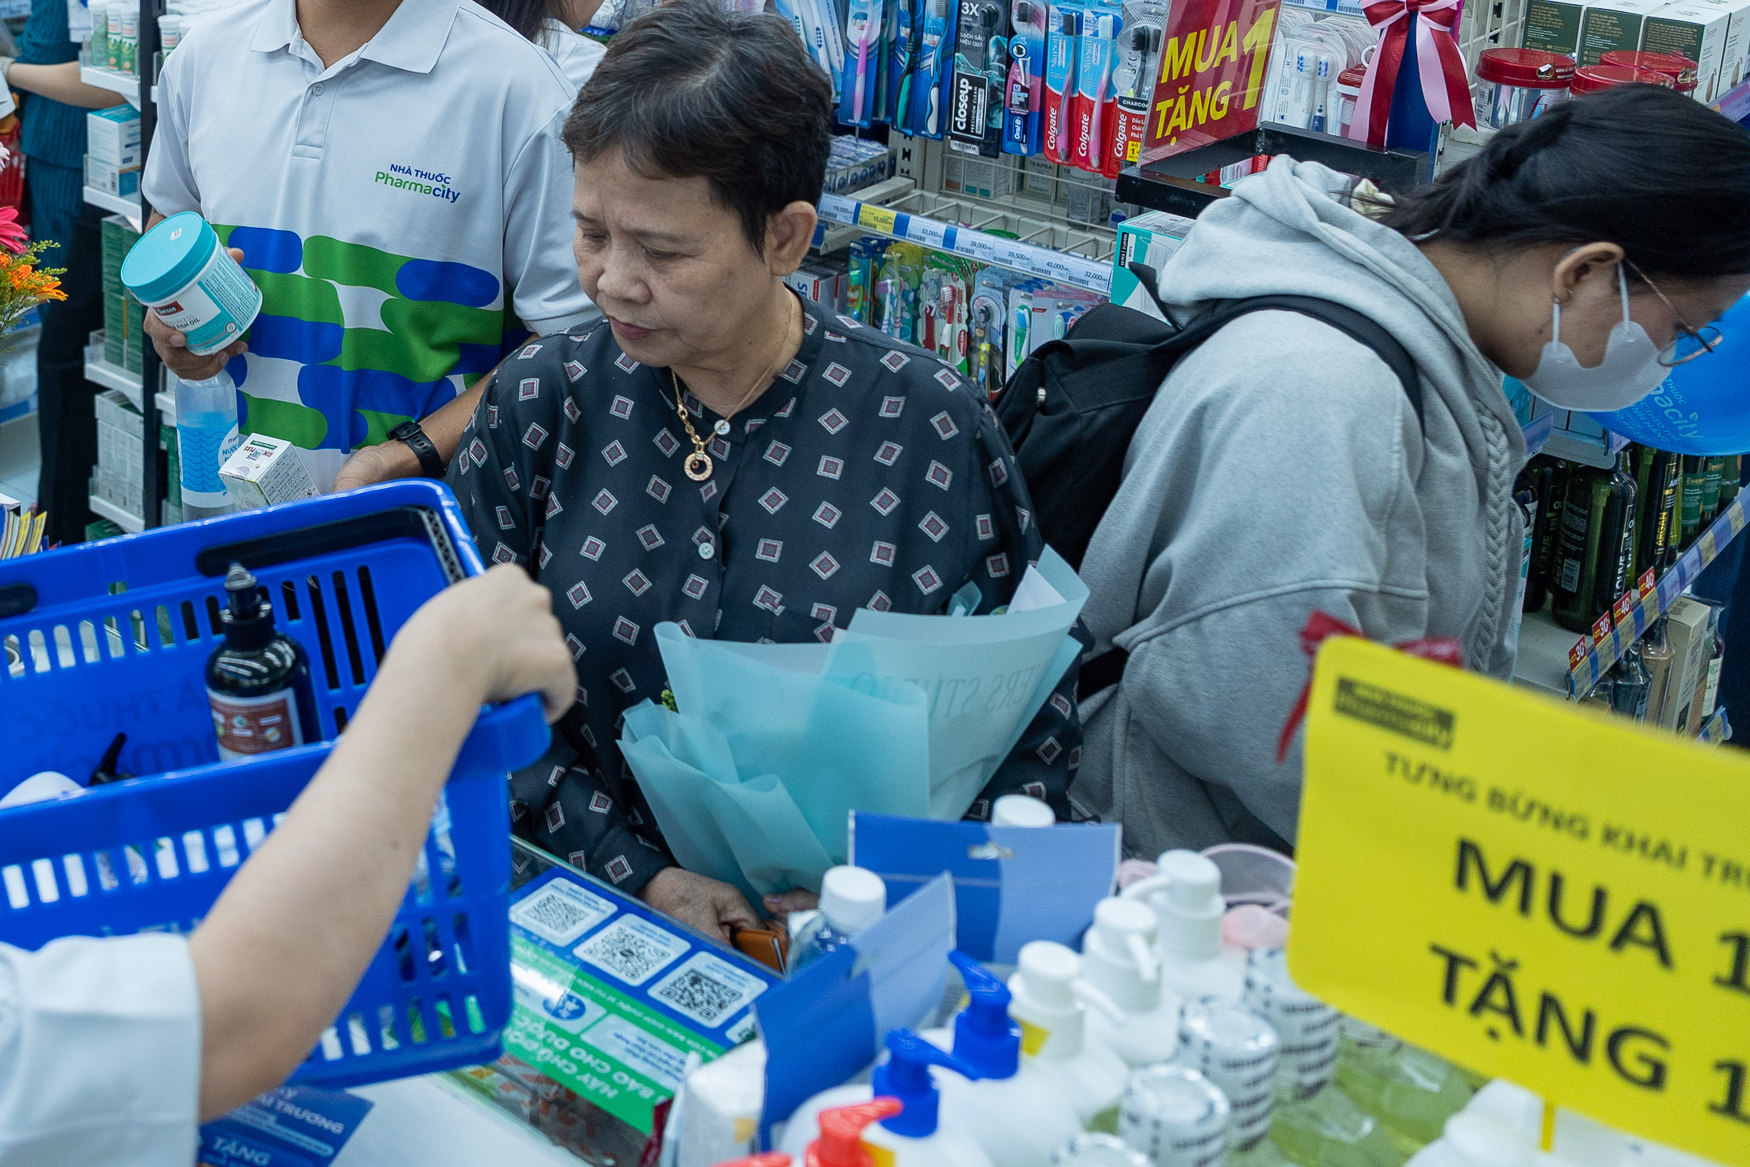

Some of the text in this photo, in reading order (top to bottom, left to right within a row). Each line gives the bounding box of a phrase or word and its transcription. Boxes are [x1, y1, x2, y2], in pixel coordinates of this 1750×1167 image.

[961, 2, 979, 16] 3X
[1161, 7, 1276, 111] MUA 1
[955, 78, 970, 131] closeup
[1156, 81, 1232, 147] TẶNG
[1048, 107, 1057, 150] Colgate
[1079, 113, 1090, 157] Colgate
[1114, 113, 1128, 158] Colgate
[375, 171, 460, 203] Pharmacity
[390, 164, 451, 184] NHÀ THUỐC
[157, 305, 177, 315] Swisse
[1455, 835, 1750, 996] MUA 1
[1427, 940, 1750, 1125] TẶNG 1
